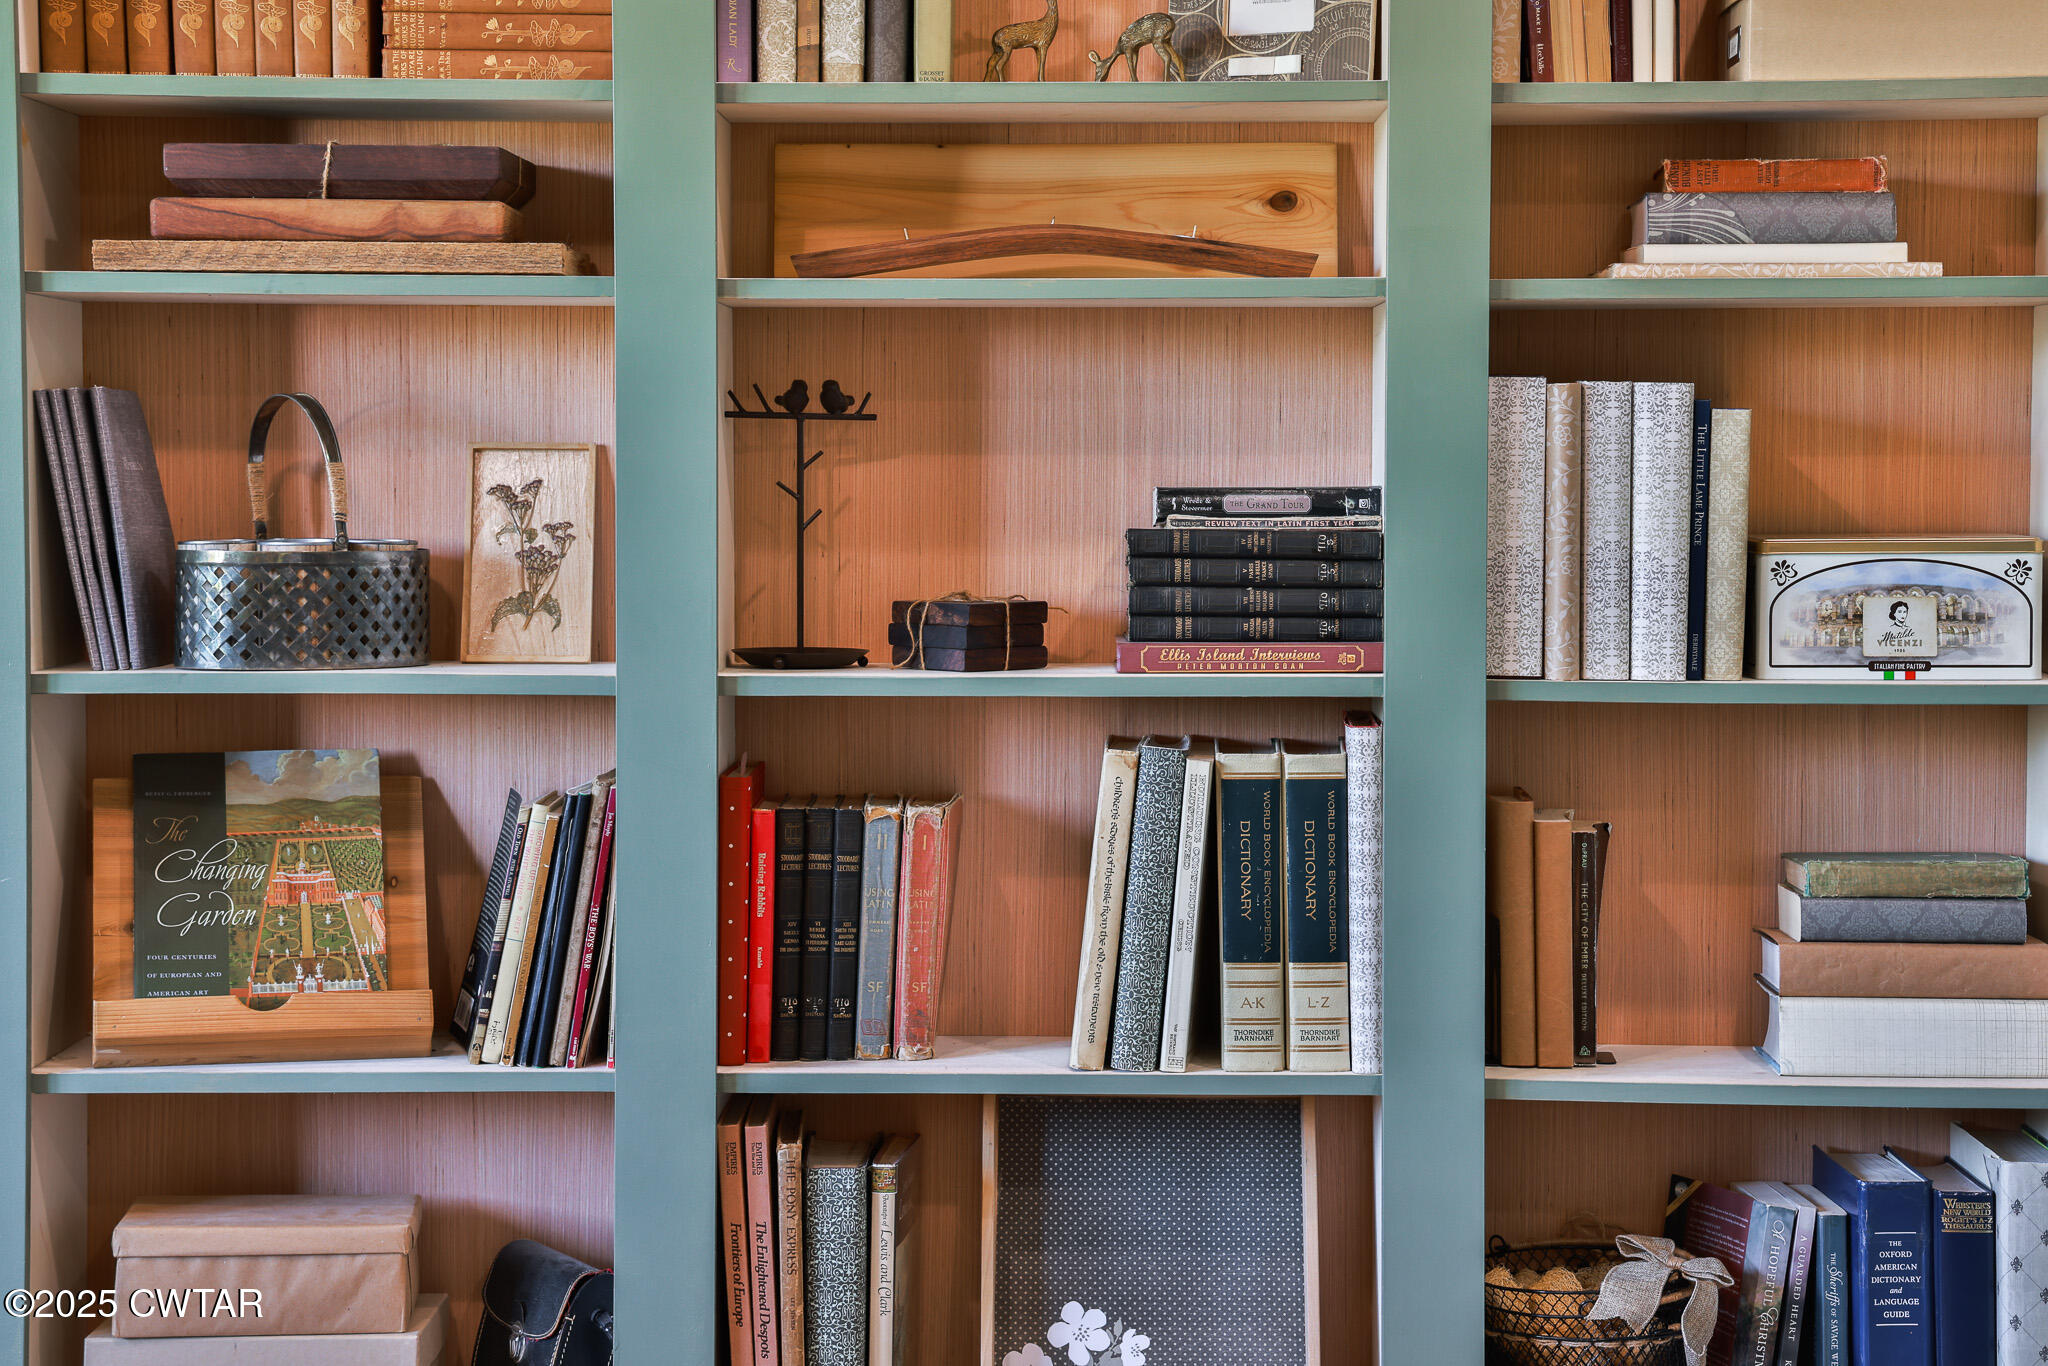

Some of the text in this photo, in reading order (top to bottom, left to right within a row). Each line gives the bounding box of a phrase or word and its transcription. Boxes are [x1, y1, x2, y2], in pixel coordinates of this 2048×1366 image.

[728, 22, 738, 49] LADY
[1693, 424, 1708, 547] THE LITTLE LAME PRINCE
[1181, 496, 1203, 505] Wrede
[1229, 498, 1305, 510] THE GRAND TOUR
[1204, 520, 1238, 528] REVIEW
[1240, 520, 1263, 528] TEXT
[1264, 520, 1275, 528] IN
[1276, 520, 1304, 528] LATIN
[1305, 520, 1331, 528] FIRST
[1183, 558, 1191, 582] LECTURES
[1877, 639, 1923, 647] VICENZI
[1881, 628, 1916, 642] Matilde
[1159, 648, 1322, 662] Ellis Island Interviews
[1691, 633, 1699, 671] DERRYDALE
[1177, 662, 1305, 670] PETER MORTON COAN
[144, 815, 199, 845] The
[1182, 774, 1198, 871] ILLUSTRATED
[1107, 822, 1118, 855] stories
[154, 838, 269, 891] Changing
[1184, 774, 1207, 953] BUILDING CONSTRUCTION
[1239, 820, 1252, 921] DICTIONARY
[1263, 790, 1271, 953] WORLD BOOK ENCYCLOPEDIA
[1303, 820, 1317, 921] DICTIONARY
[1327, 790, 1336, 953] WORLD BOOK ENCYCLOPEDIA
[756, 852, 767, 918] Raising Rabbits
[1581, 882, 1589, 900] THE
[156, 890, 257, 937] Garden
[1099, 905, 1111, 930] from
[1581, 902, 1589, 923] CITY
[1098, 930, 1110, 947] the
[1581, 926, 1589, 938] OF
[171, 953, 217, 961] CENTURIES
[1096, 947, 1107, 963] old
[1581, 941, 1589, 969] EMBER
[867, 981, 884, 993] SF
[911, 982, 928, 993] SF
[1093, 970, 1103, 992] new
[1240, 996, 1266, 1010] A-K
[1307, 996, 1330, 1009] L-Z
[1087, 992, 1102, 1044] testaments
[1580, 1002, 1588, 1032] EDITION
[1233, 1035, 1275, 1043] BARNHART
[1299, 1035, 1340, 1043] BARNHART
[729, 1142, 738, 1176] EMPIRES
[755, 1142, 763, 1176] EMPIRES
[785, 1159, 797, 1182] THE
[786, 1187, 796, 1221] PONY
[1943, 1198, 1991, 1209] WEBSTER'S
[1771, 1219, 1786, 1245] A
[787, 1227, 797, 1276] EXPRESS
[880, 1229, 893, 1261] Lewis
[1879, 1250, 1913, 1258] OXFORD
[730, 1222, 745, 1328] Frontiers of Europe
[880, 1263, 891, 1284] and
[1763, 1245, 1780, 1307] HOPEFUL
[1874, 1263, 1918, 1271] AMERICAN
[755, 1221, 771, 1359] The Enlightened Despots
[1787, 1234, 1808, 1342] A GUARDED HEART
[1825, 1265, 1844, 1307] Sheriffs
[1871, 1276, 1922, 1284] DICTIONARY
[1889, 1286, 1903, 1294] and
[878, 1286, 892, 1316] Clark
[1830, 1308, 1837, 1318] OF
[1873, 1298, 1920, 1306] LANGUAGE
[1830, 1319, 1839, 1350] SAVAGE
